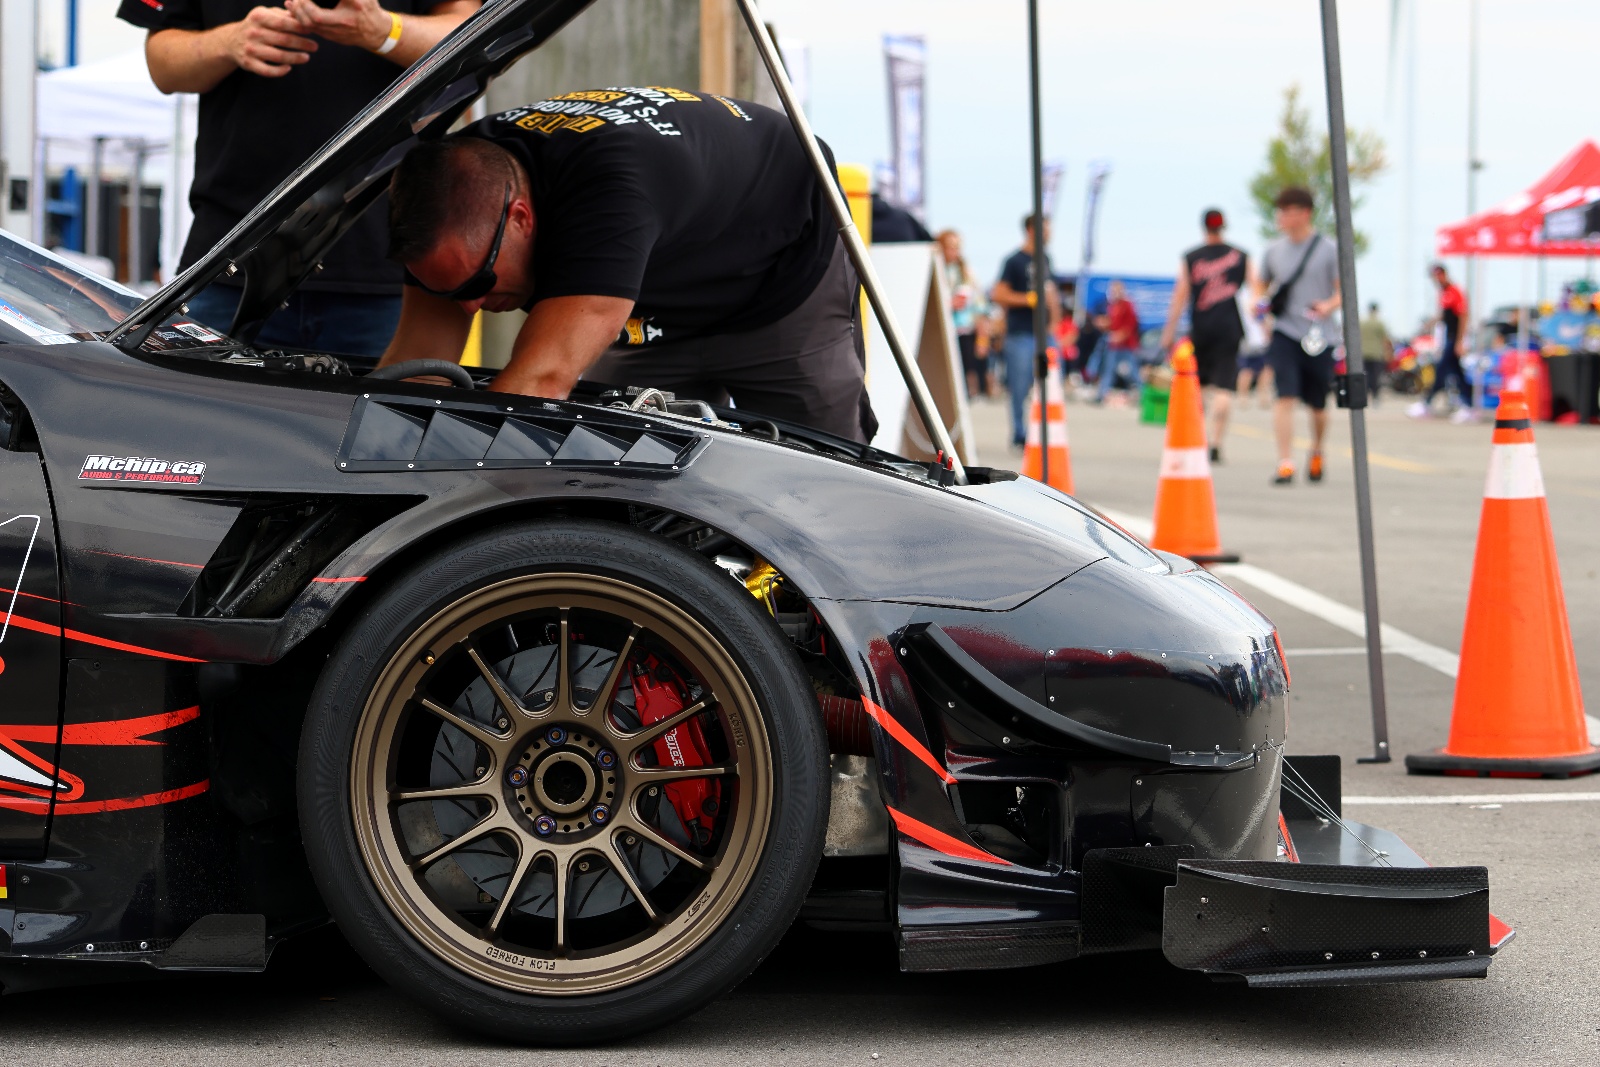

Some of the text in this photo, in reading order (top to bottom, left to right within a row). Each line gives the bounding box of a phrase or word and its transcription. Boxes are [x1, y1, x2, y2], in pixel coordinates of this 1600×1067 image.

[616, 96, 644, 107] A
[496, 109, 529, 122] IS
[634, 106, 682, 136] IT'S
[84, 456, 205, 475] Mchip.ca
[81, 471, 112, 479] AUDIO
[125, 472, 201, 483] PERFORMANCE
[486, 947, 556, 971] FLOW FORMED
